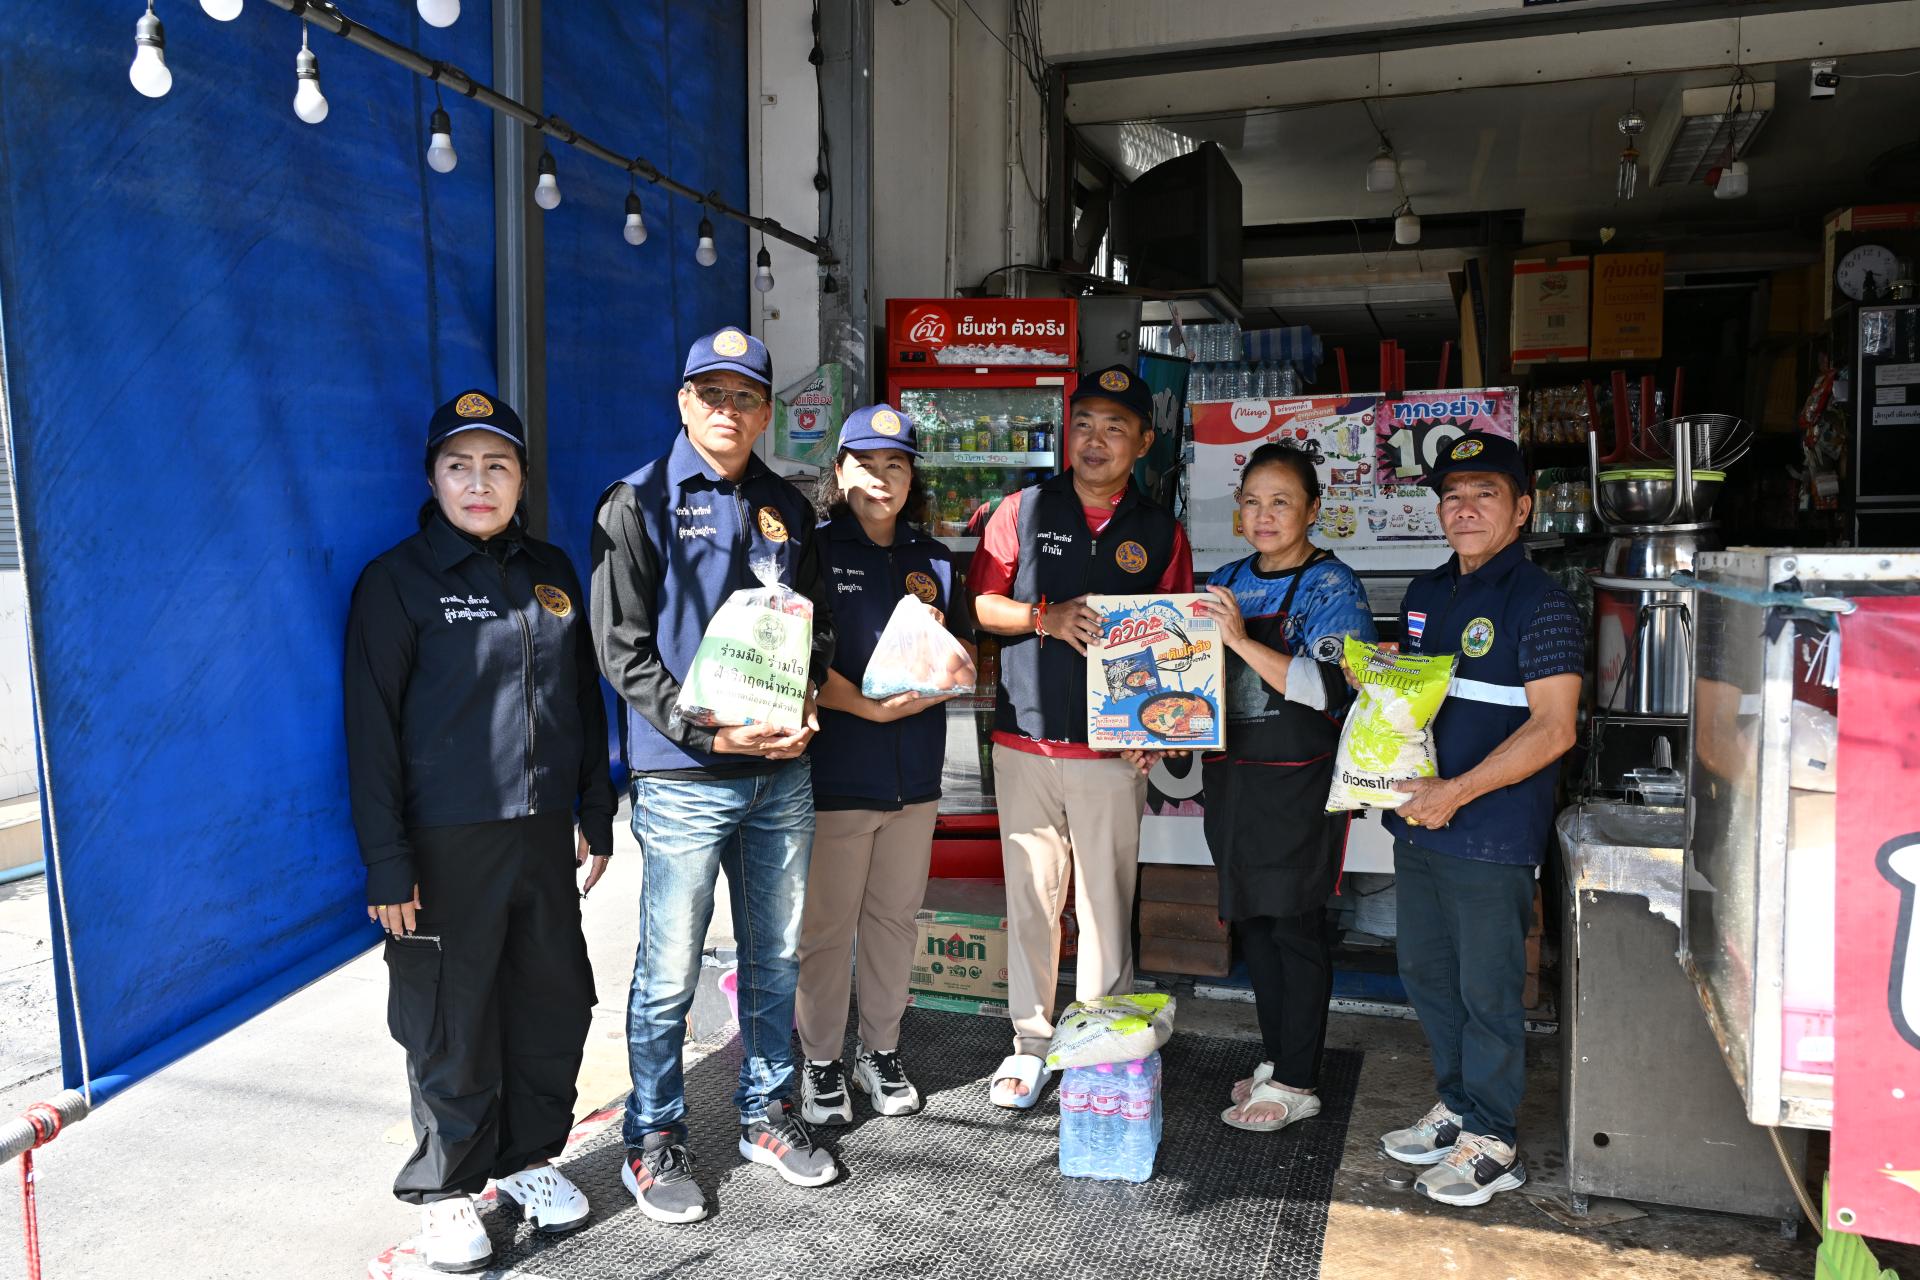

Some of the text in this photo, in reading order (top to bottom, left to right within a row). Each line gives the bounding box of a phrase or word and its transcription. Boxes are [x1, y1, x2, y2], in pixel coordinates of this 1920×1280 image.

[957, 316, 1006, 336] เย็นซ่า
[1012, 317, 1065, 336] ตัวจริง
[1234, 407, 1268, 419] Mingo
[1392, 395, 1496, 425] ทุกอย่าง
[1042, 542, 1062, 556] กำนัน
[444, 607, 498, 624] ผู้ช่วยผู้ใหญ่บ้าน
[721, 643, 763, 665] ร่วมมือ
